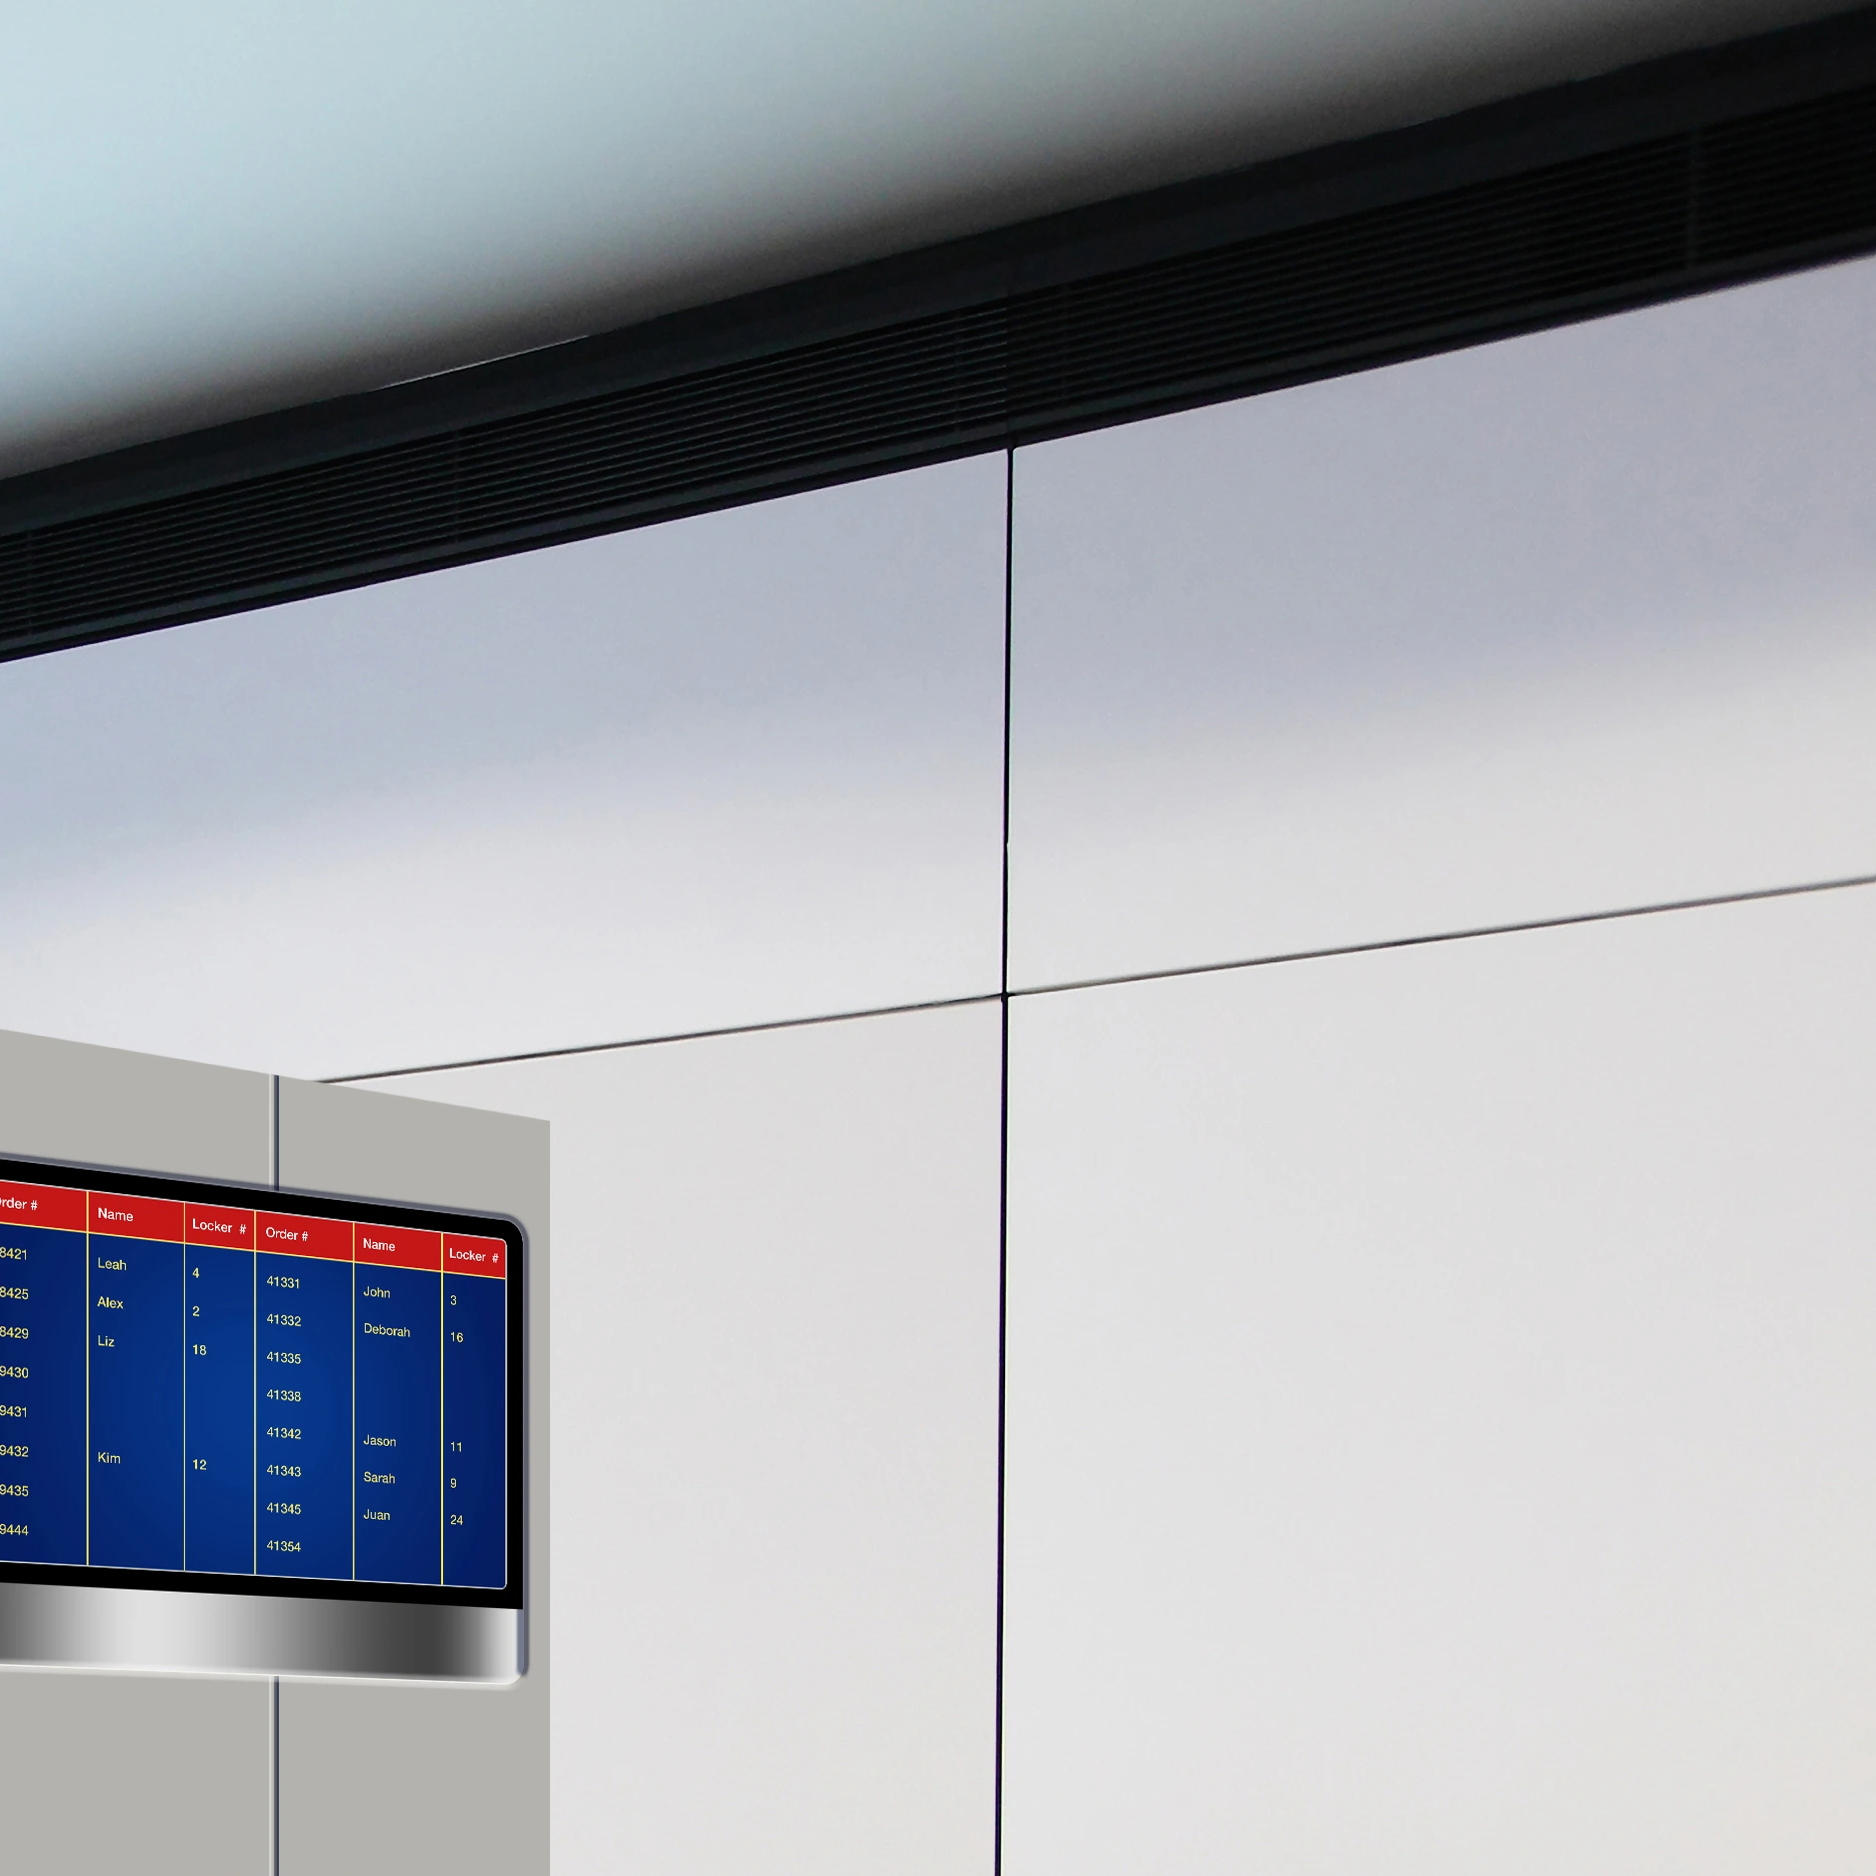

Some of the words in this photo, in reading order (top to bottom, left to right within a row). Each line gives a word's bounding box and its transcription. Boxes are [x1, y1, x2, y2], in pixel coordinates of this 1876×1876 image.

[30, 1199, 38, 1211] #
[97, 1207, 134, 1222] Name
[192, 1217, 233, 1233] Locker
[239, 1223, 247, 1235] #
[265, 1226, 299, 1241] Order
[301, 1230, 309, 1242] #
[363, 1237, 396, 1252] Name
[449, 1247, 487, 1262] Locker
[492, 1253, 499, 1264] #
[98, 1257, 127, 1271] Leah
[192, 1267, 200, 1279] 4
[266, 1275, 299, 1289] 41331
[363, 1285, 391, 1298] John
[450, 1294, 457, 1306] 3
[97, 1295, 124, 1310] Alex
[192, 1305, 200, 1317] 2
[266, 1313, 302, 1327] 41332
[364, 1322, 411, 1337] Deborah
[450, 1331, 464, 1343] 16
[97, 1334, 115, 1347] Liz
[192, 1343, 207, 1356] 18
[266, 1351, 302, 1365] 41335
[266, 1389, 302, 1402] 41338
[266, 1426, 302, 1440] 41342
[363, 1434, 397, 1447] Jason
[450, 1441, 462, 1452] 11
[97, 1451, 121, 1464] Kim
[192, 1458, 207, 1471] 12
[266, 1464, 302, 1478] 41343
[363, 1471, 396, 1484] Sarah
[450, 1477, 457, 1489] 9
[266, 1502, 302, 1515] 41345
[363, 1508, 391, 1521] Juan
[450, 1514, 464, 1526] 24
[266, 1539, 302, 1552] 41354
